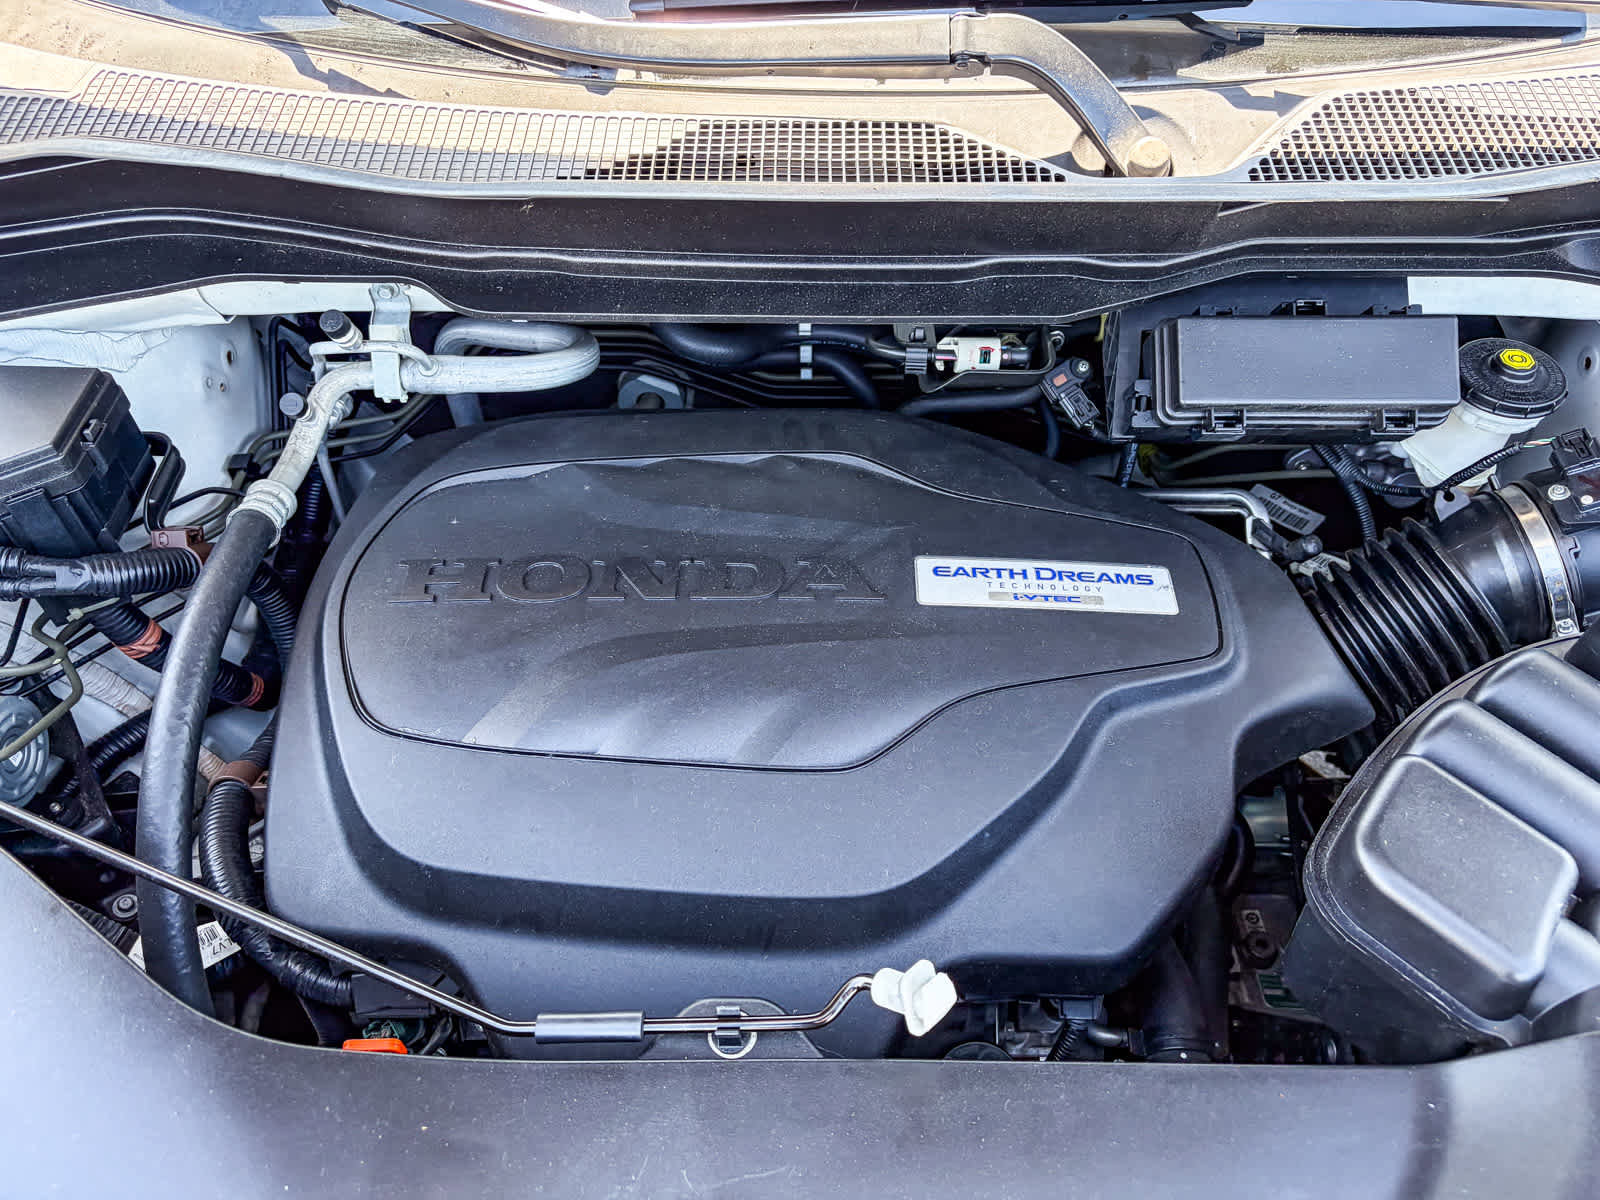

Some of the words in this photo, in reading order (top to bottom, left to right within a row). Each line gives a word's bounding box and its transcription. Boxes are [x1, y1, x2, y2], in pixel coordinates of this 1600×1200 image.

[388, 556, 887, 605] HONDA
[932, 565, 1028, 580] EARTH
[1035, 567, 1154, 585] DREAMS
[986, 581, 1103, 593] TECHNOLOGY
[1013, 592, 1081, 603] i-VTEC
